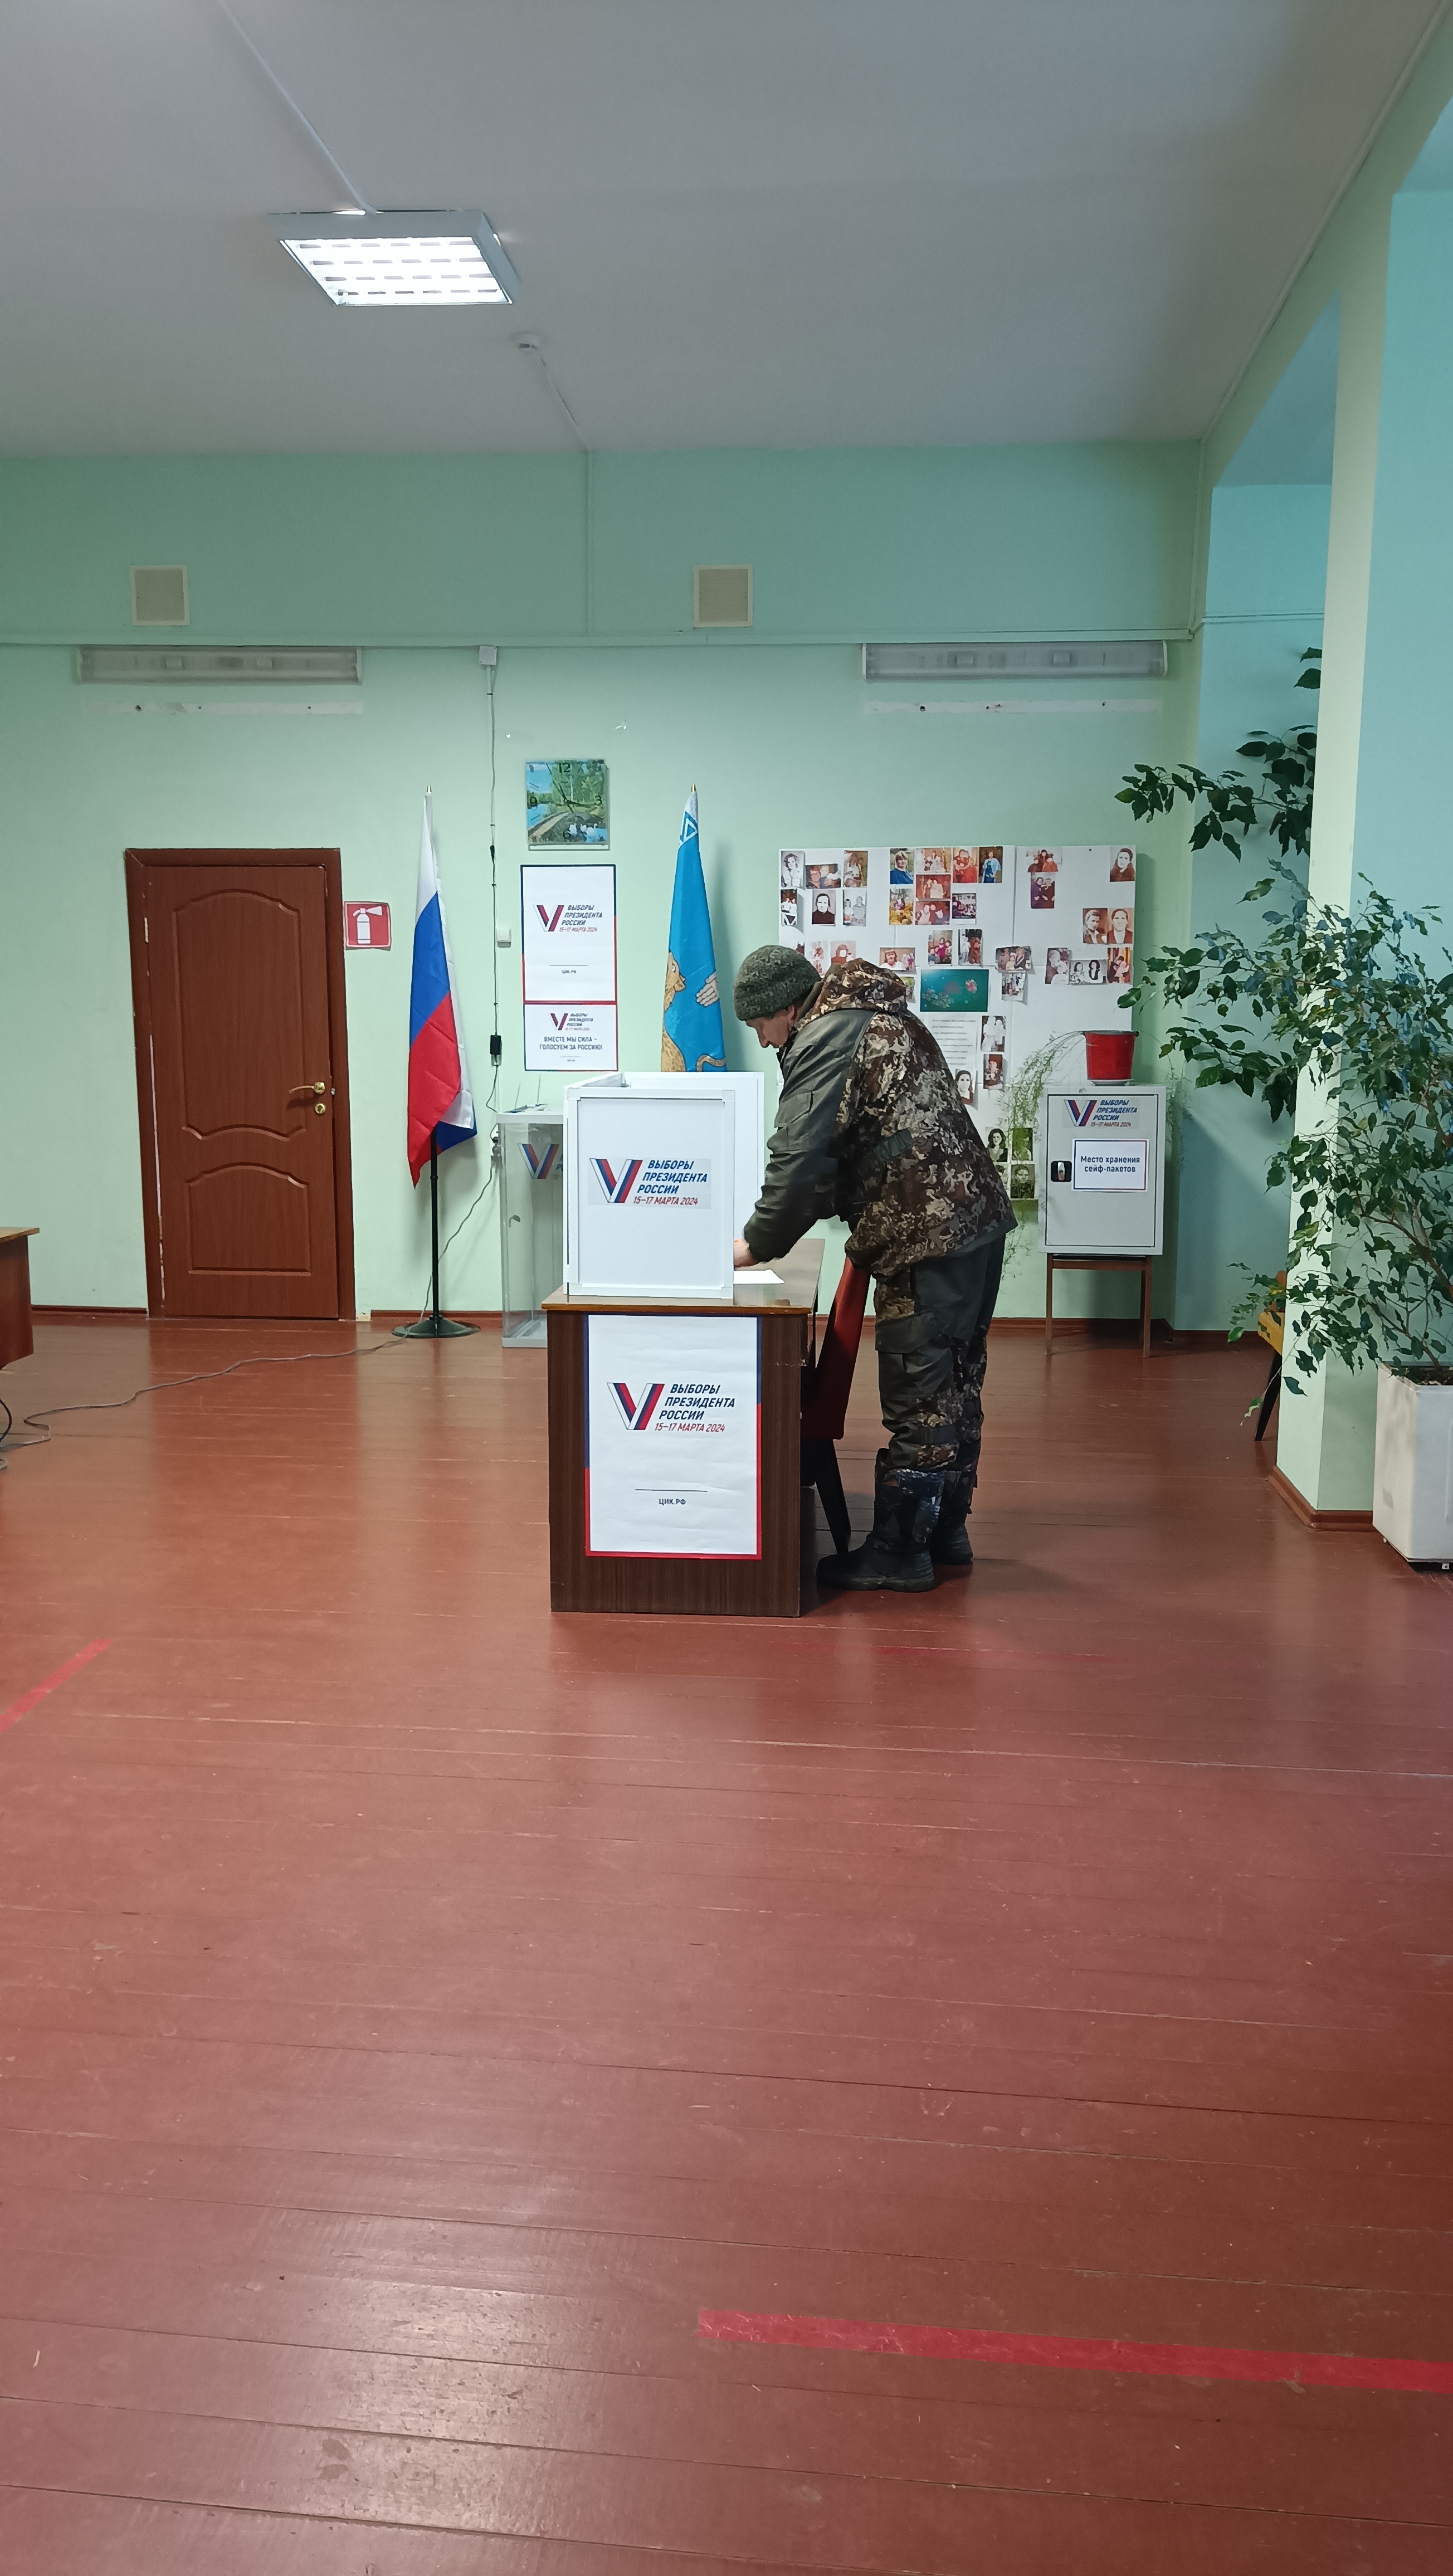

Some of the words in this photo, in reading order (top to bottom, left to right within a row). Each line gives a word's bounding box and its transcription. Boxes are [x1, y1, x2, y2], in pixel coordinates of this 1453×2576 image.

[559, 763, 571, 773] 12
[529, 797, 538, 807] 9
[594, 795, 603, 805] 3
[647, 1160, 694, 1170] ВЫБОРЫ
[1084, 1164, 1135, 1173] сейф-пакетов
[642, 1172, 708, 1183] ПРЕЗИДЕНТА
[637, 1184, 680, 1194] РОССИИ
[655, 1197, 679, 1205] МАРТА
[670, 1384, 721, 1394] ВЫБОРЫ
[664, 1397, 735, 1408] ПРЕЗИДЕНТА
[659, 1410, 705, 1420] РОССИИ
[677, 1423, 705, 1432] МАРТА
[705, 1424, 725, 1432] 2024
